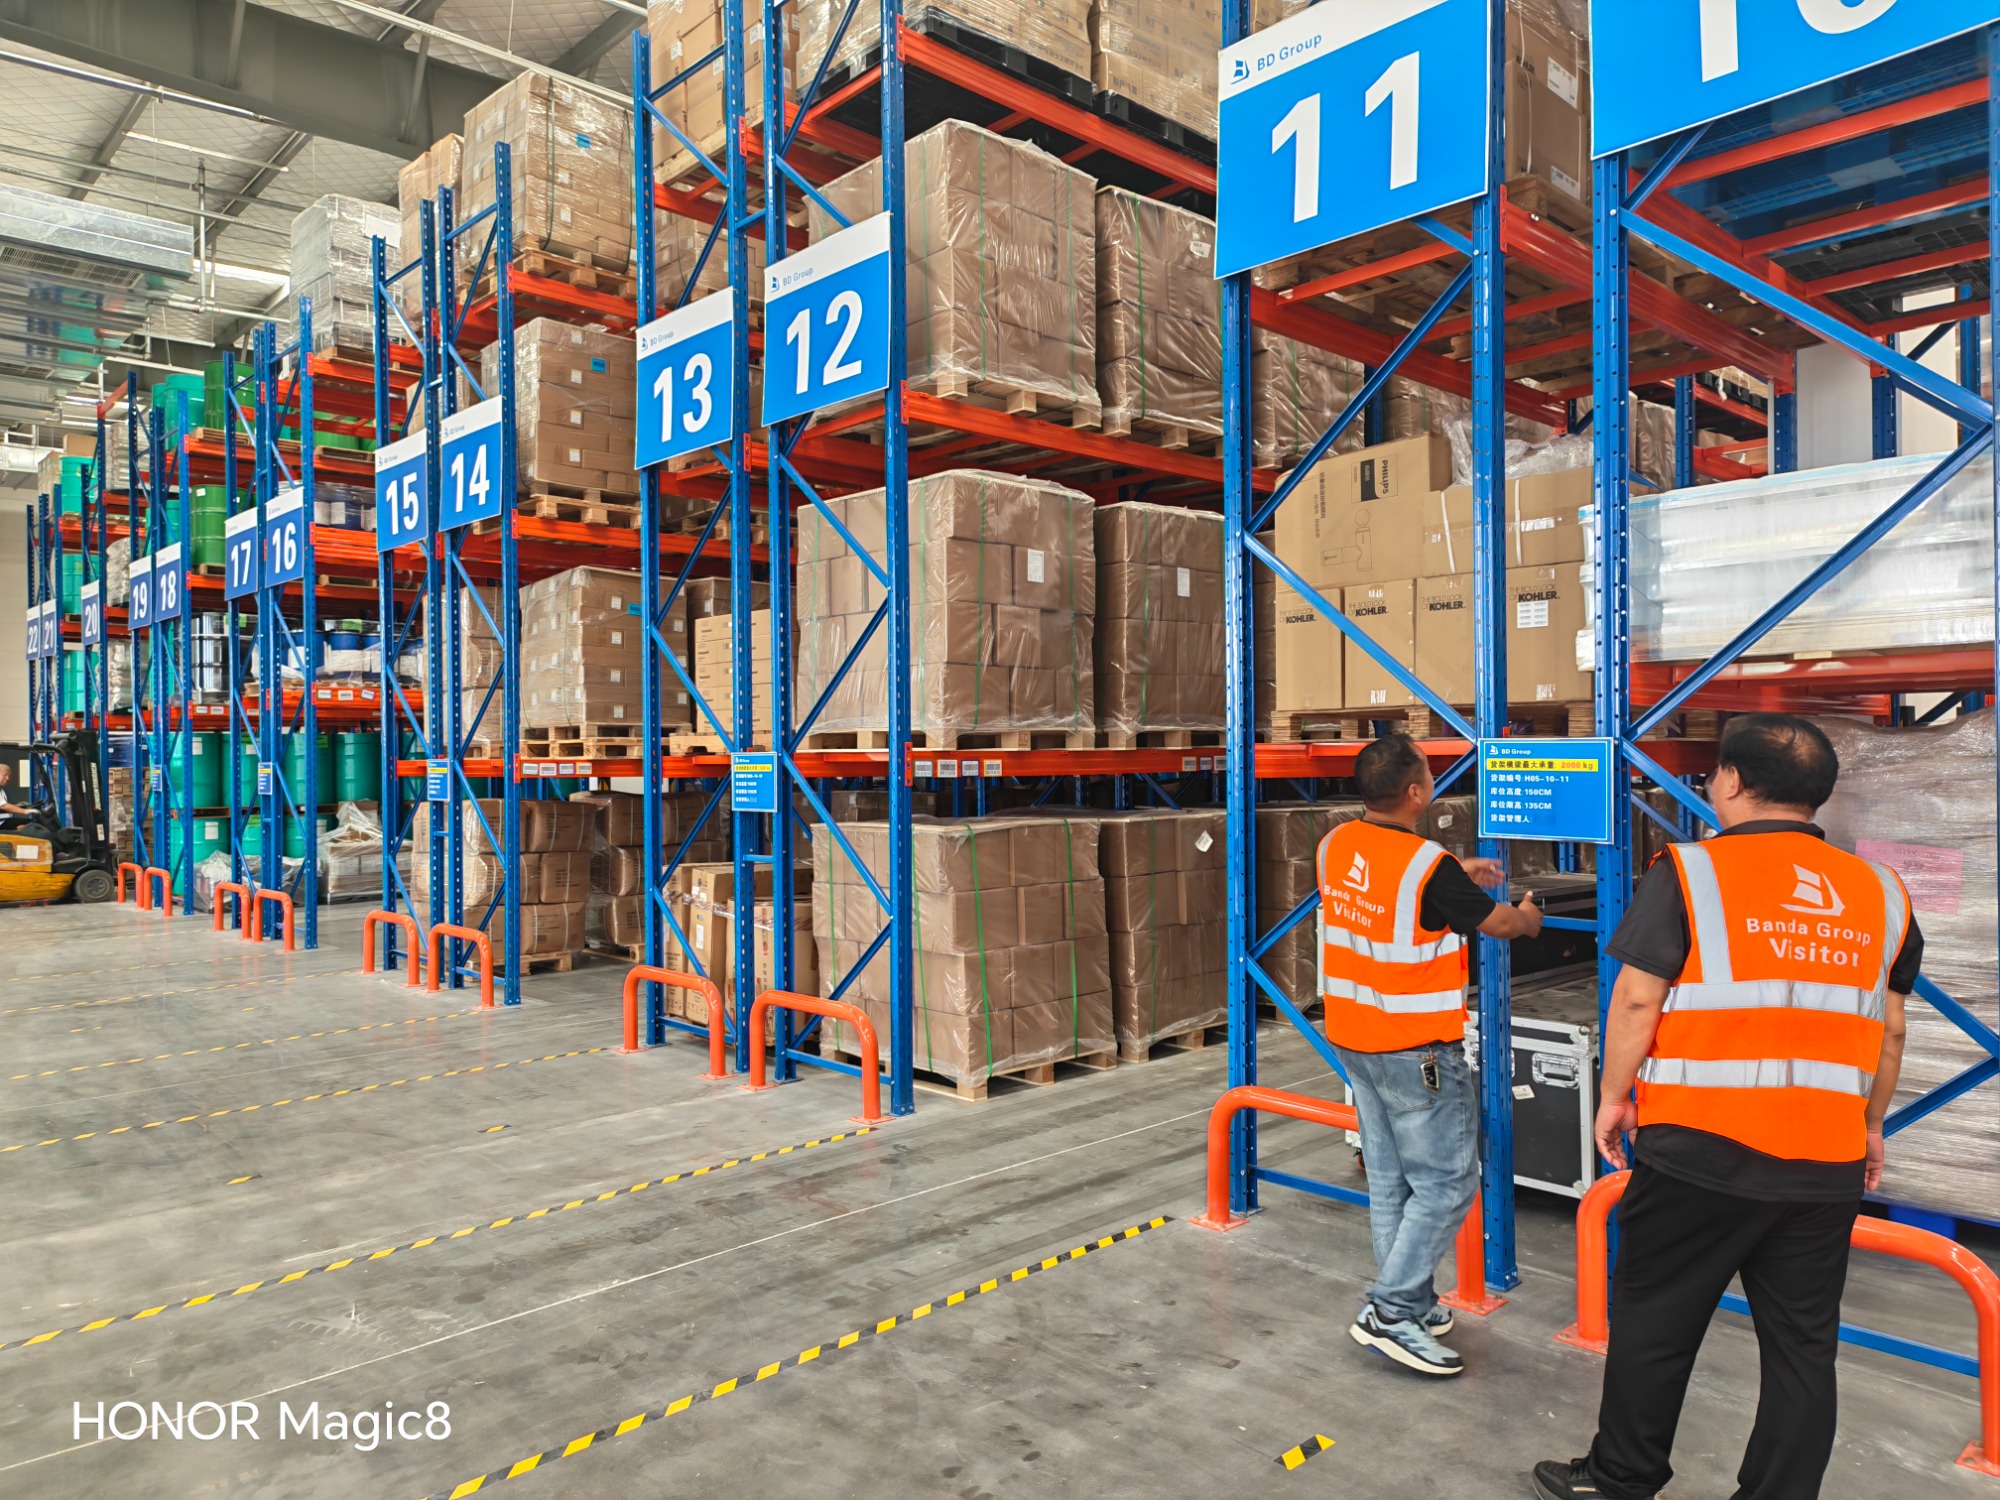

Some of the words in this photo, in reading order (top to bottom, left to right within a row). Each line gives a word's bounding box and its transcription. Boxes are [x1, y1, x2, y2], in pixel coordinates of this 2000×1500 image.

[1257, 53, 1275, 71] BD
[1279, 34, 1322, 60] Group
[1271, 50, 1420, 224] 11
[783, 276, 792, 286] BD
[793, 267, 814, 281] Group
[786, 290, 863, 395] 12
[653, 352, 713, 443] 13
[451, 443, 490, 513] 14
[386, 472, 419, 535] 15
[231, 539, 251, 588] 17
[272, 522, 297, 574] 16
[133, 581, 148, 620] 19
[160, 570, 176, 612] 18
[44, 619, 54, 650] 21
[84, 603, 97, 638] 20
[28, 625, 38, 655] 22
[1511, 748, 1532, 756] Group
[1561, 761, 1581, 769] 2000
[1582, 762, 1594, 770] kg
[1333, 900, 1373, 928] Visitor
[1355, 895, 1386, 915] Group
[1746, 917, 1809, 935] Banda
[1816, 922, 1871, 947] Group
[1768, 937, 1860, 967] Visitor
